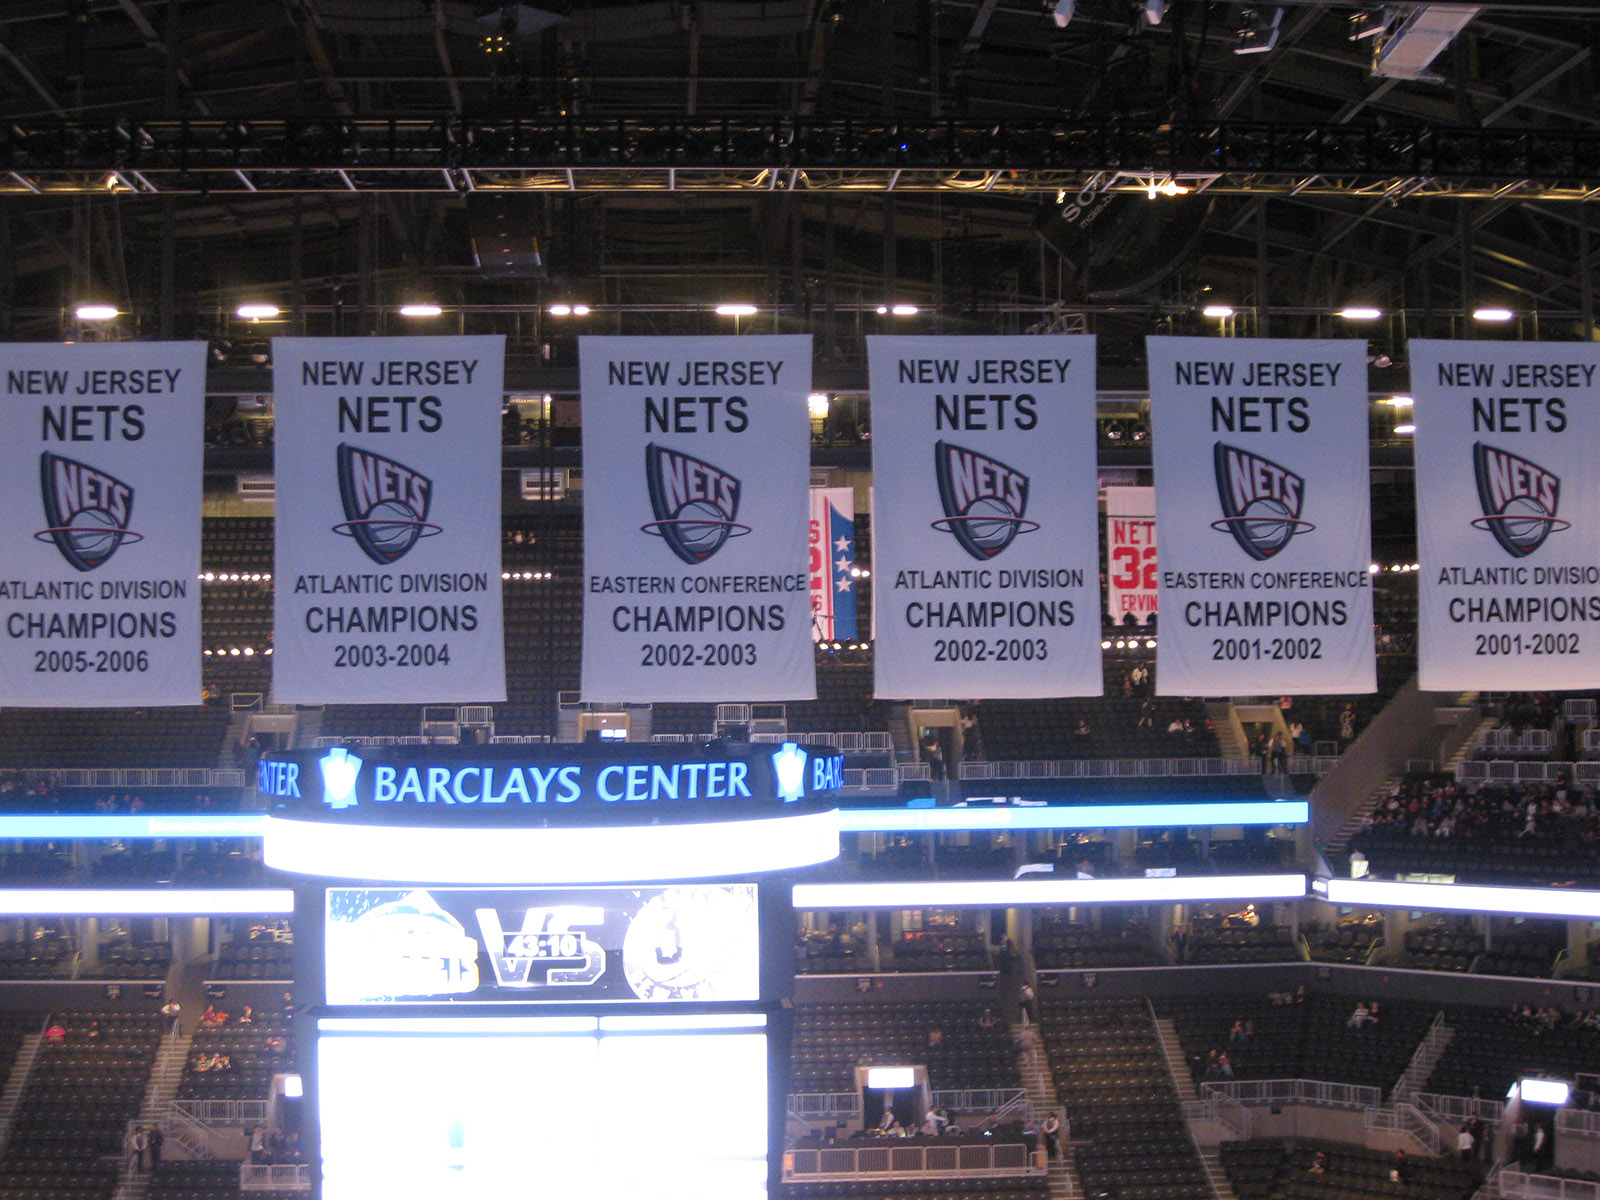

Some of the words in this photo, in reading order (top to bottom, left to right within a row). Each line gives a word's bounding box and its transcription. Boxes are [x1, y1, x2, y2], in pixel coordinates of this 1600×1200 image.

[8, 370, 68, 394] NEW
[76, 369, 181, 395] JERSEY
[303, 361, 364, 385] NEW
[372, 360, 478, 386] JERSEY
[609, 361, 670, 386] NEW
[678, 361, 783, 386] JERSEY
[899, 360, 959, 384] NEW
[968, 359, 1071, 384] JERSEY
[1176, 361, 1234, 386] NEW
[1242, 363, 1342, 387] JERSEY
[1438, 363, 1494, 387] NEW
[1502, 364, 1596, 388] JERSEY
[42, 405, 145, 441] NETS
[338, 396, 442, 433] NETS
[645, 396, 748, 433] NETS
[936, 394, 1038, 431] NETS
[1211, 396, 1310, 433] NETS
[1472, 397, 1567, 433] NETS
[54, 459, 130, 525] NETS
[352, 451, 428, 519] NETS
[660, 451, 736, 520] NETS
[949, 448, 1025, 516] NETS
[1227, 449, 1300, 517] NETS
[1487, 449, 1556, 516] NETS
[1114, 520, 1157, 545] NET
[294, 574, 393, 594] ATLANTIC
[401, 573, 487, 593] DIVISION
[590, 576, 675, 593] EASTERN
[682, 574, 806, 593] CONFERENCE
[895, 570, 992, 589] ATLANTIC
[999, 569, 1083, 588] DIVISION
[1163, 572, 1244, 589] EASTERN
[1251, 571, 1368, 589] CONFERENCE
[1438, 567, 1527, 585] ATLANTIC
[1534, 566, 1600, 585] DIVISIO
[0, 581, 93, 600] ATLANTIC
[101, 580, 186, 599] DIVISION
[1121, 594, 1158, 611] ERVIN
[305, 605, 478, 633] CHAMPIONS
[613, 604, 785, 632] CHAMPIONS
[906, 600, 1075, 628] CHAMPIONS
[1185, 600, 1348, 627] CHAMPIONS
[1449, 596, 1600, 623] CHAMPIONS
[7, 612, 177, 638] CHAMPIONS
[335, 644, 450, 667] 2003-2004
[641, 643, 757, 666] 2002-2003
[934, 639, 1048, 662] 2002-2003
[1213, 638, 1322, 660] 2001-2002
[1476, 633, 1580, 655] 2001-2002
[35, 650, 148, 672] 2005-2006
[374, 765, 582, 804] BARCLAYS
[596, 761, 752, 802] CENTER
[507, 934, 577, 957] 43:10
